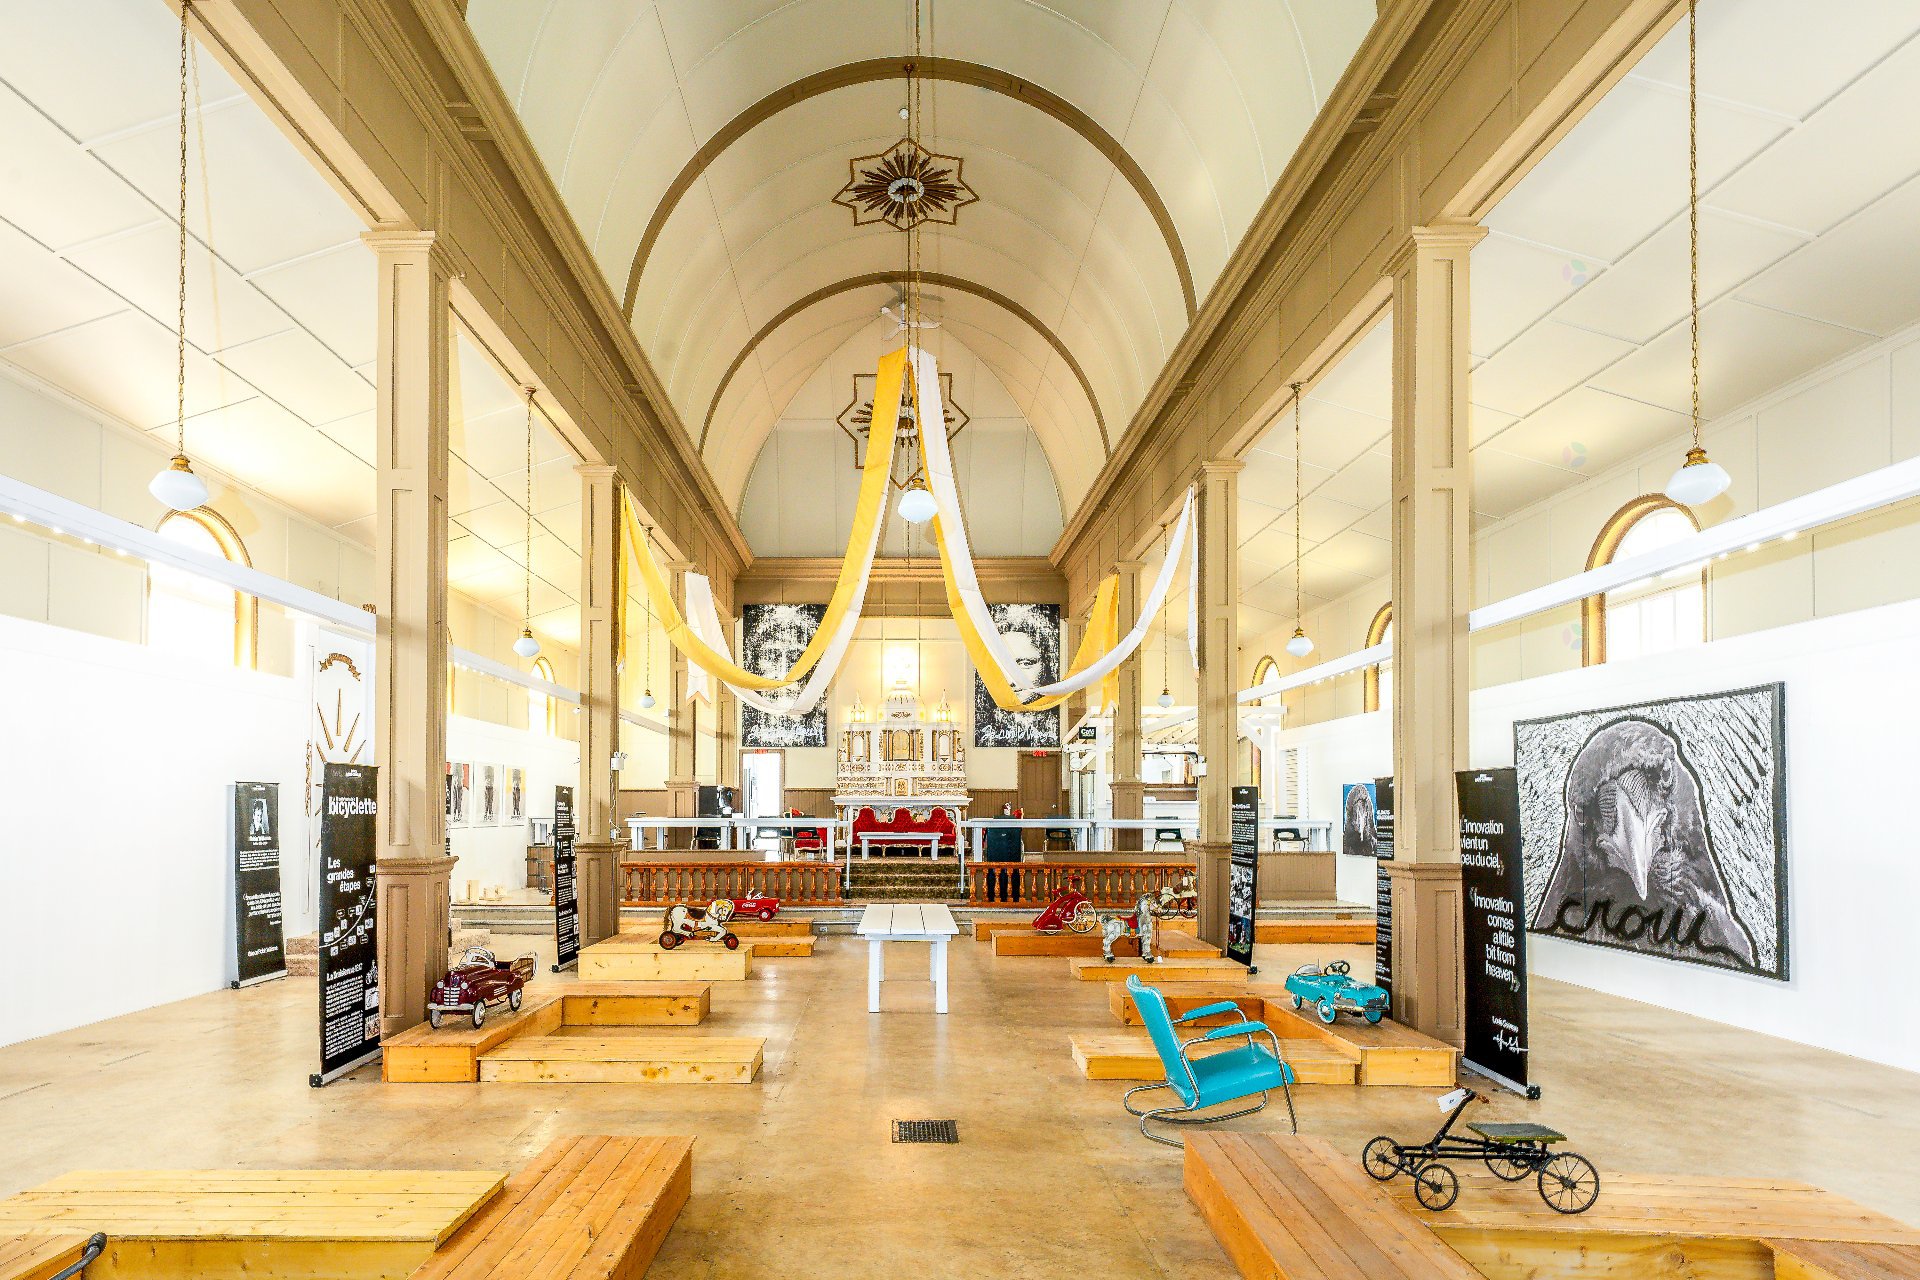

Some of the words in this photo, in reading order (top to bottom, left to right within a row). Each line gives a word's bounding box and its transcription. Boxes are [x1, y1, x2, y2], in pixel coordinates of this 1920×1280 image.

[328, 796, 377, 818] bicyclette
[327, 856, 341, 869] Les
[1475, 852, 1485, 868] du
[327, 868, 354, 884] grandes
[340, 881, 361, 893] étapes
[1487, 914, 1515, 931] comes
[1492, 932, 1499, 945] a
[1498, 930, 1515, 949] little
[1485, 943, 1496, 961] bit
[1496, 946, 1516, 967] from
